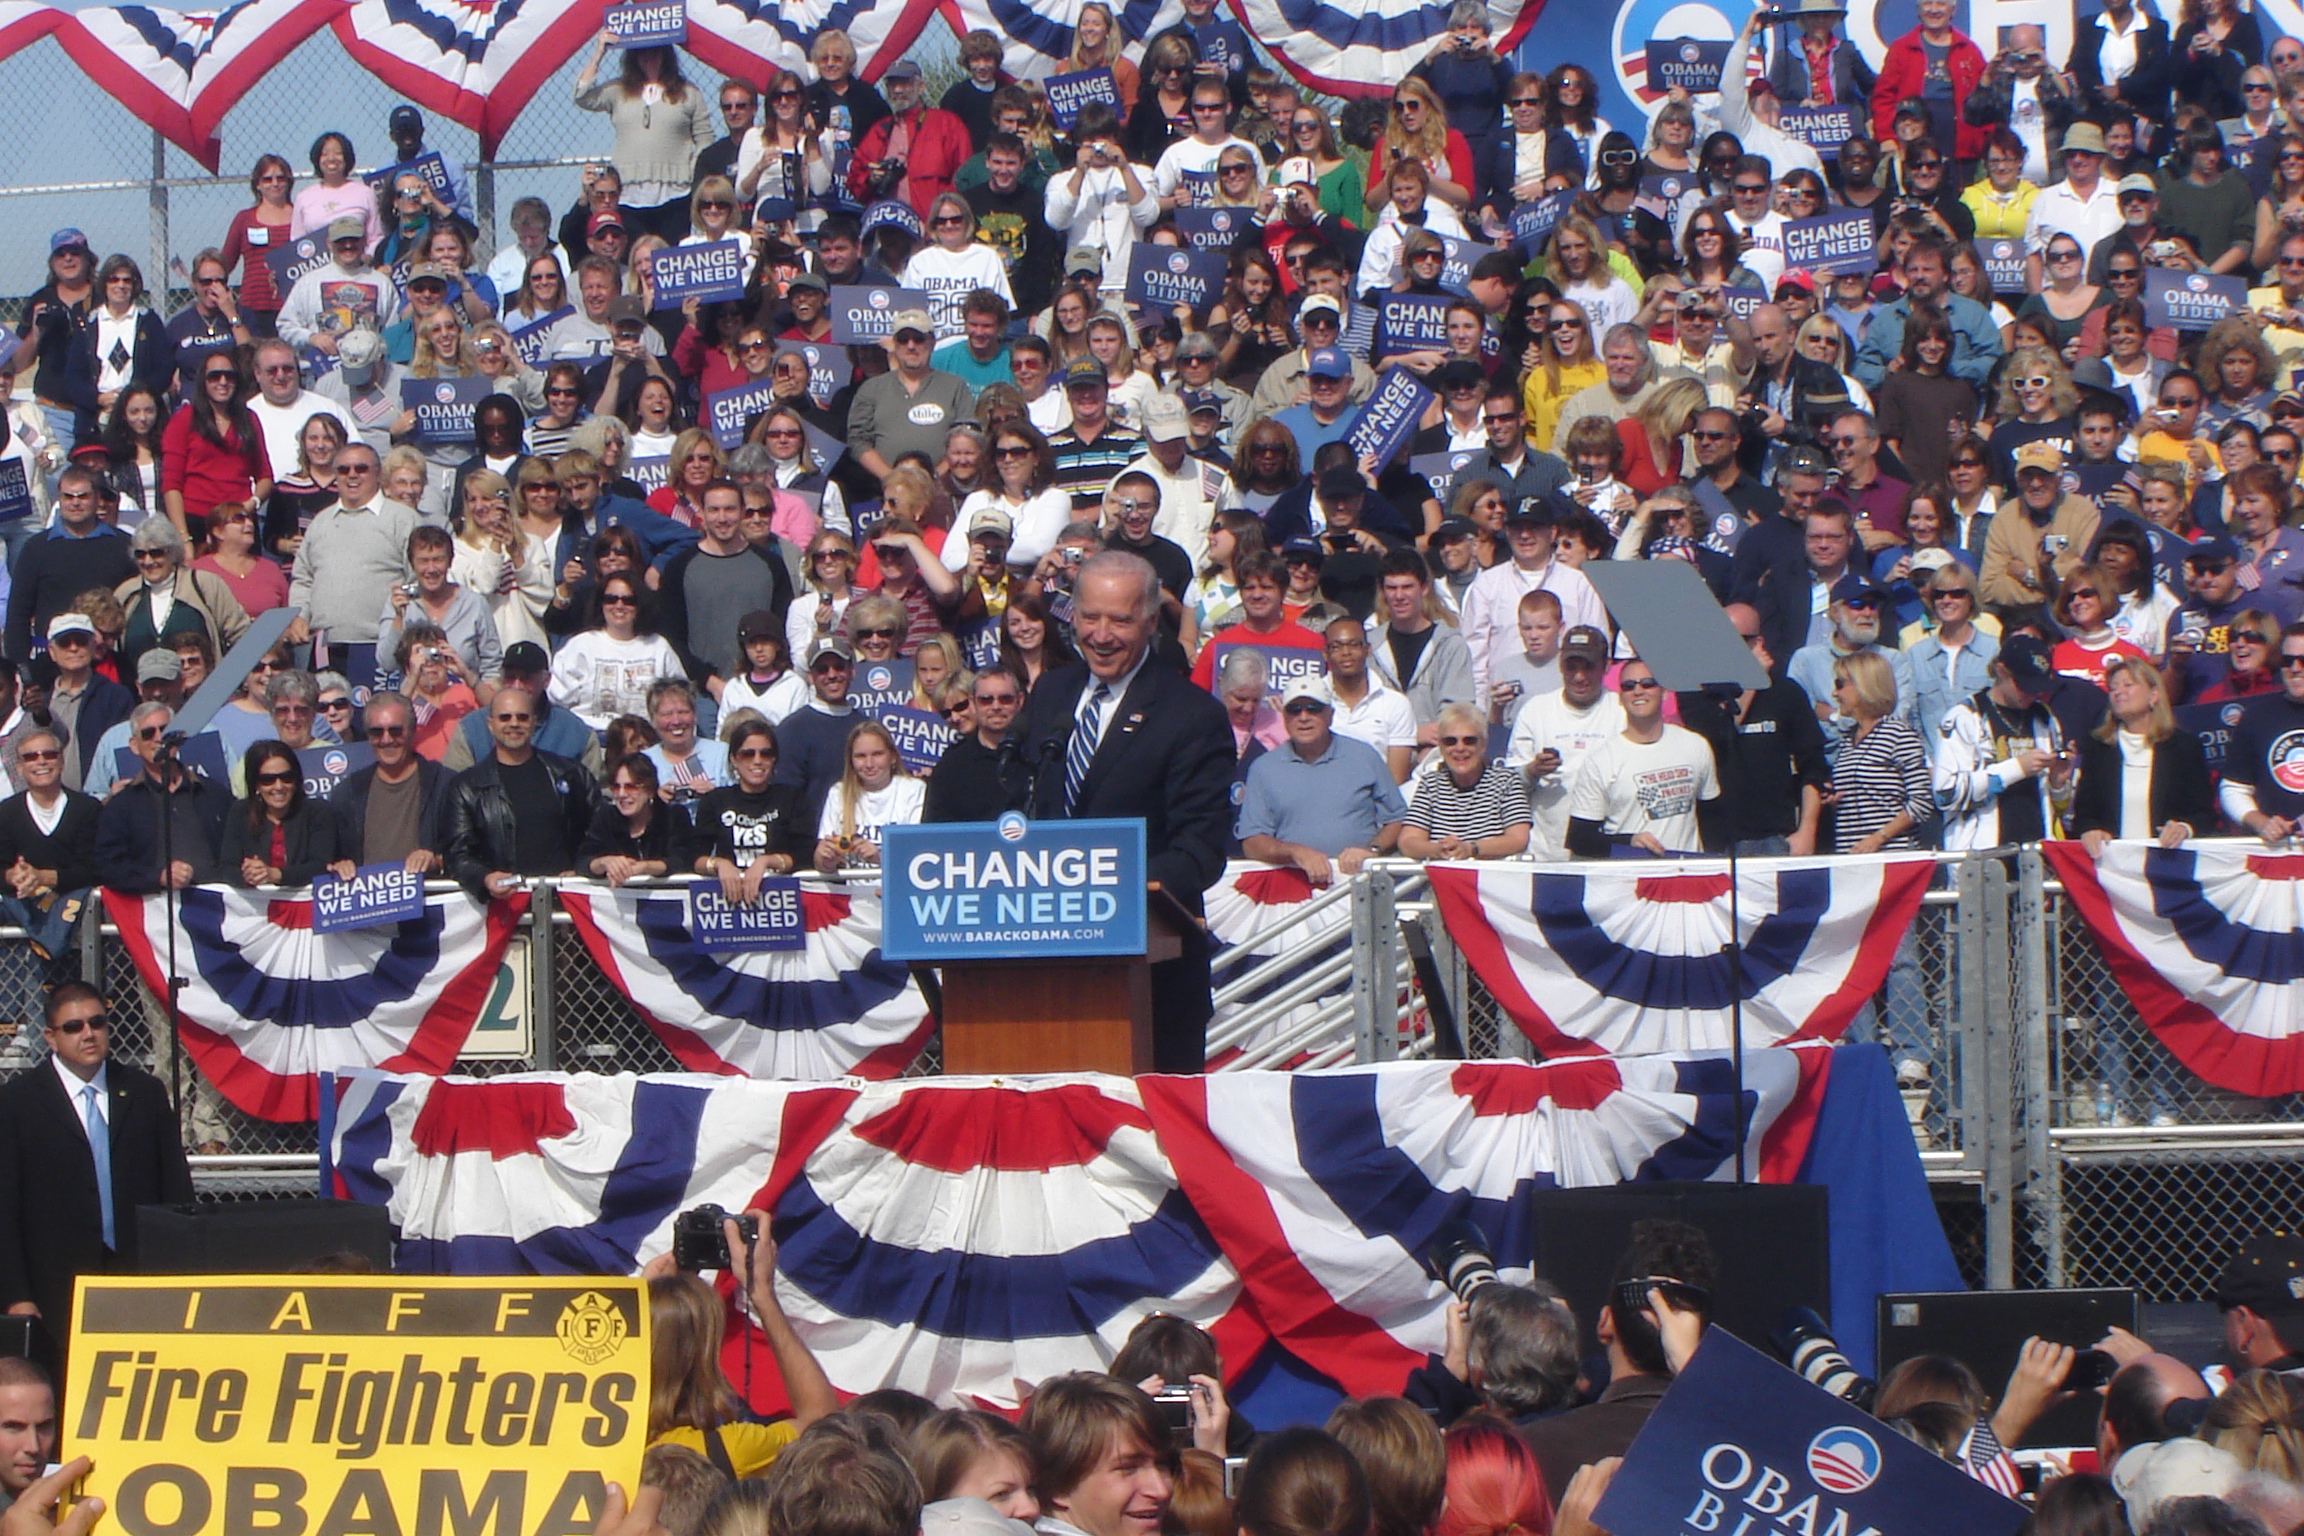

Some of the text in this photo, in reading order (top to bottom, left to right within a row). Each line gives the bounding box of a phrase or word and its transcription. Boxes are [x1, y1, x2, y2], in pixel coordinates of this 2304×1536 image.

[607, 5, 683, 25] CHANGE
[608, 19, 683, 35] WE NEED
[1661, 62, 1720, 76] OBAMA
[1050, 76, 1112, 101] CHANGE
[1665, 75, 1716, 88] BIDEN
[1053, 98, 1078, 115] WE
[1780, 113, 1850, 131] CHANGE
[1811, 128, 1852, 143] NEED
[1193, 231, 1239, 246] OBAM
[1786, 218, 1872, 247] CHANGE
[1788, 244, 1819, 262] WE
[1823, 237, 1874, 257] NEED
[656, 249, 738, 274] CHANGE
[657, 265, 738, 289] WE NEED
[1143, 270, 1207, 293] OBAMA
[1146, 285, 1203, 304] BIDEN
[2164, 289, 2231, 308] OBAMA
[847, 309, 900, 323] OBAM
[1385, 303, 1446, 324] CHAN
[2167, 304, 2227, 320] BIDEN
[852, 321, 895, 334] BIDE
[1385, 321, 1447, 340] WE NE
[418, 402, 477, 419] OBAMA
[714, 387, 775, 418] CHAN
[1381, 383, 1418, 431] NEED
[423, 418, 476, 431] BIDEN
[717, 412, 747, 432] WE
[912, 410, 942, 420] Miller
[882, 714, 964, 745] CHANG
[732, 823, 768, 847] YES
[909, 848, 1119, 891] CHANGE
[317, 870, 417, 902] CHANGE
[318, 886, 418, 916] WE NEED
[695, 890, 797, 913] CHGE
[909, 890, 1118, 927] WE NEED
[697, 911, 799, 930] WE NEED
[923, 929, 1105, 943] WWW.BARACKOBAMA.COM
[76, 1350, 637, 1460] Fire Fighters
[115, 1462, 608, 1536] OBAMA
[1701, 1443, 1883, 1536] OBAM
